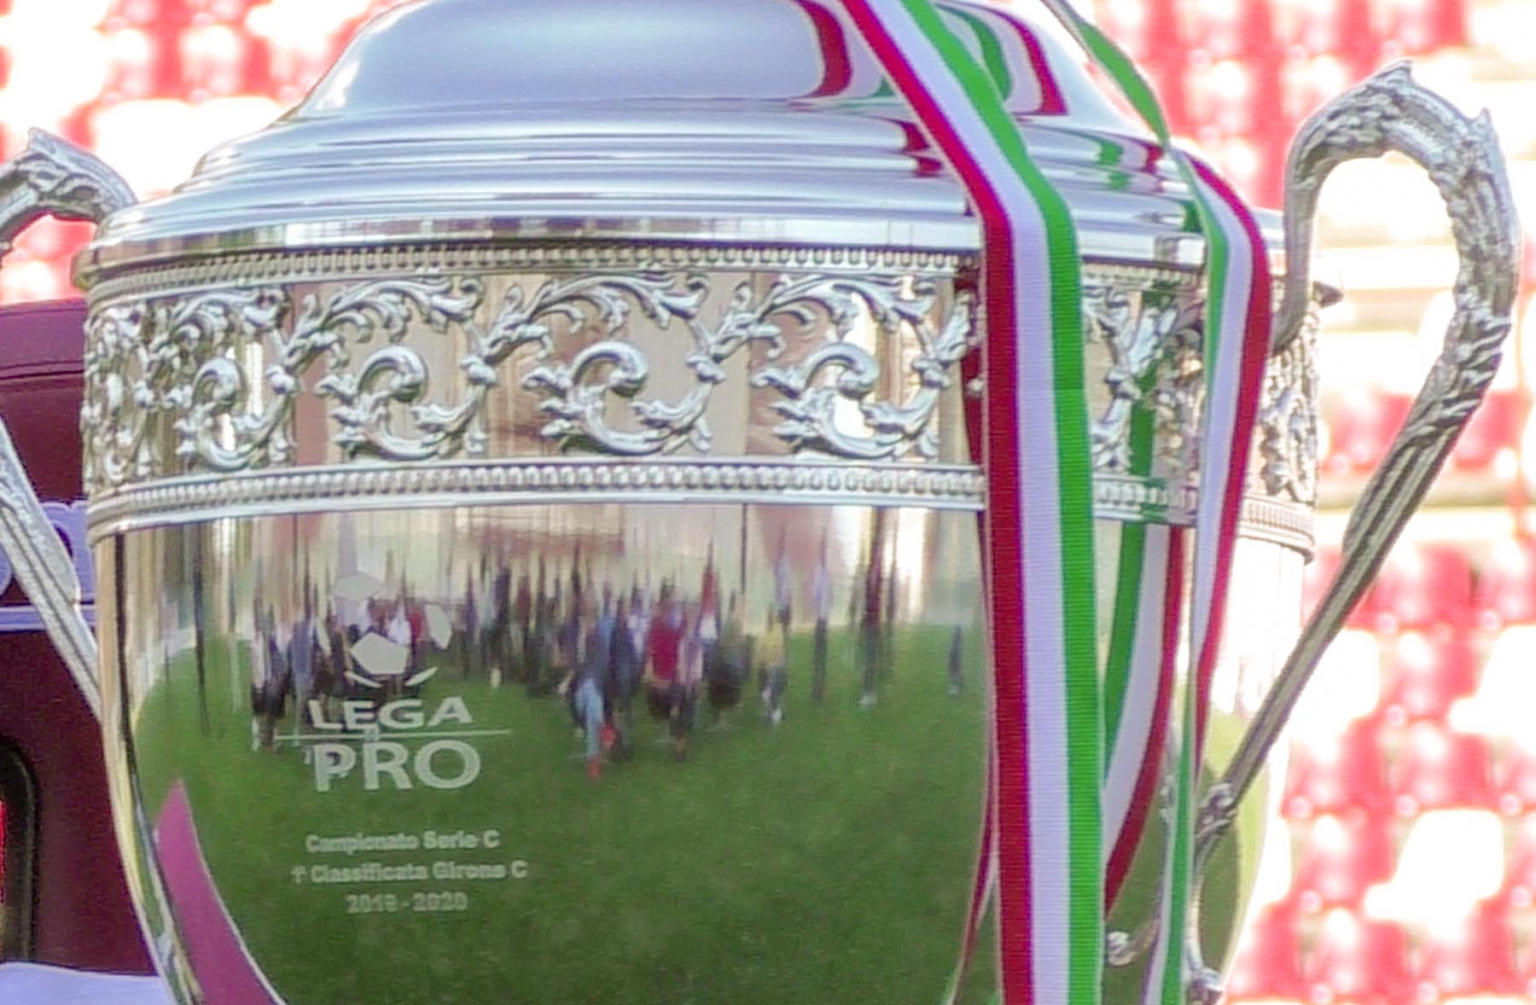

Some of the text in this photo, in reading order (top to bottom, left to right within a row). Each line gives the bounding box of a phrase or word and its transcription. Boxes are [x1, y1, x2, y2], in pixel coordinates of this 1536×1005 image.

[308, 696, 474, 731] LEGA
[312, 739, 481, 792] PRO
[305, 829, 501, 855] Campionato Serie C
[310, 862, 429, 884] Classificata
[432, 861, 507, 880] Girone
[510, 859, 529, 879] C
[413, 891, 469, 912] 2020
